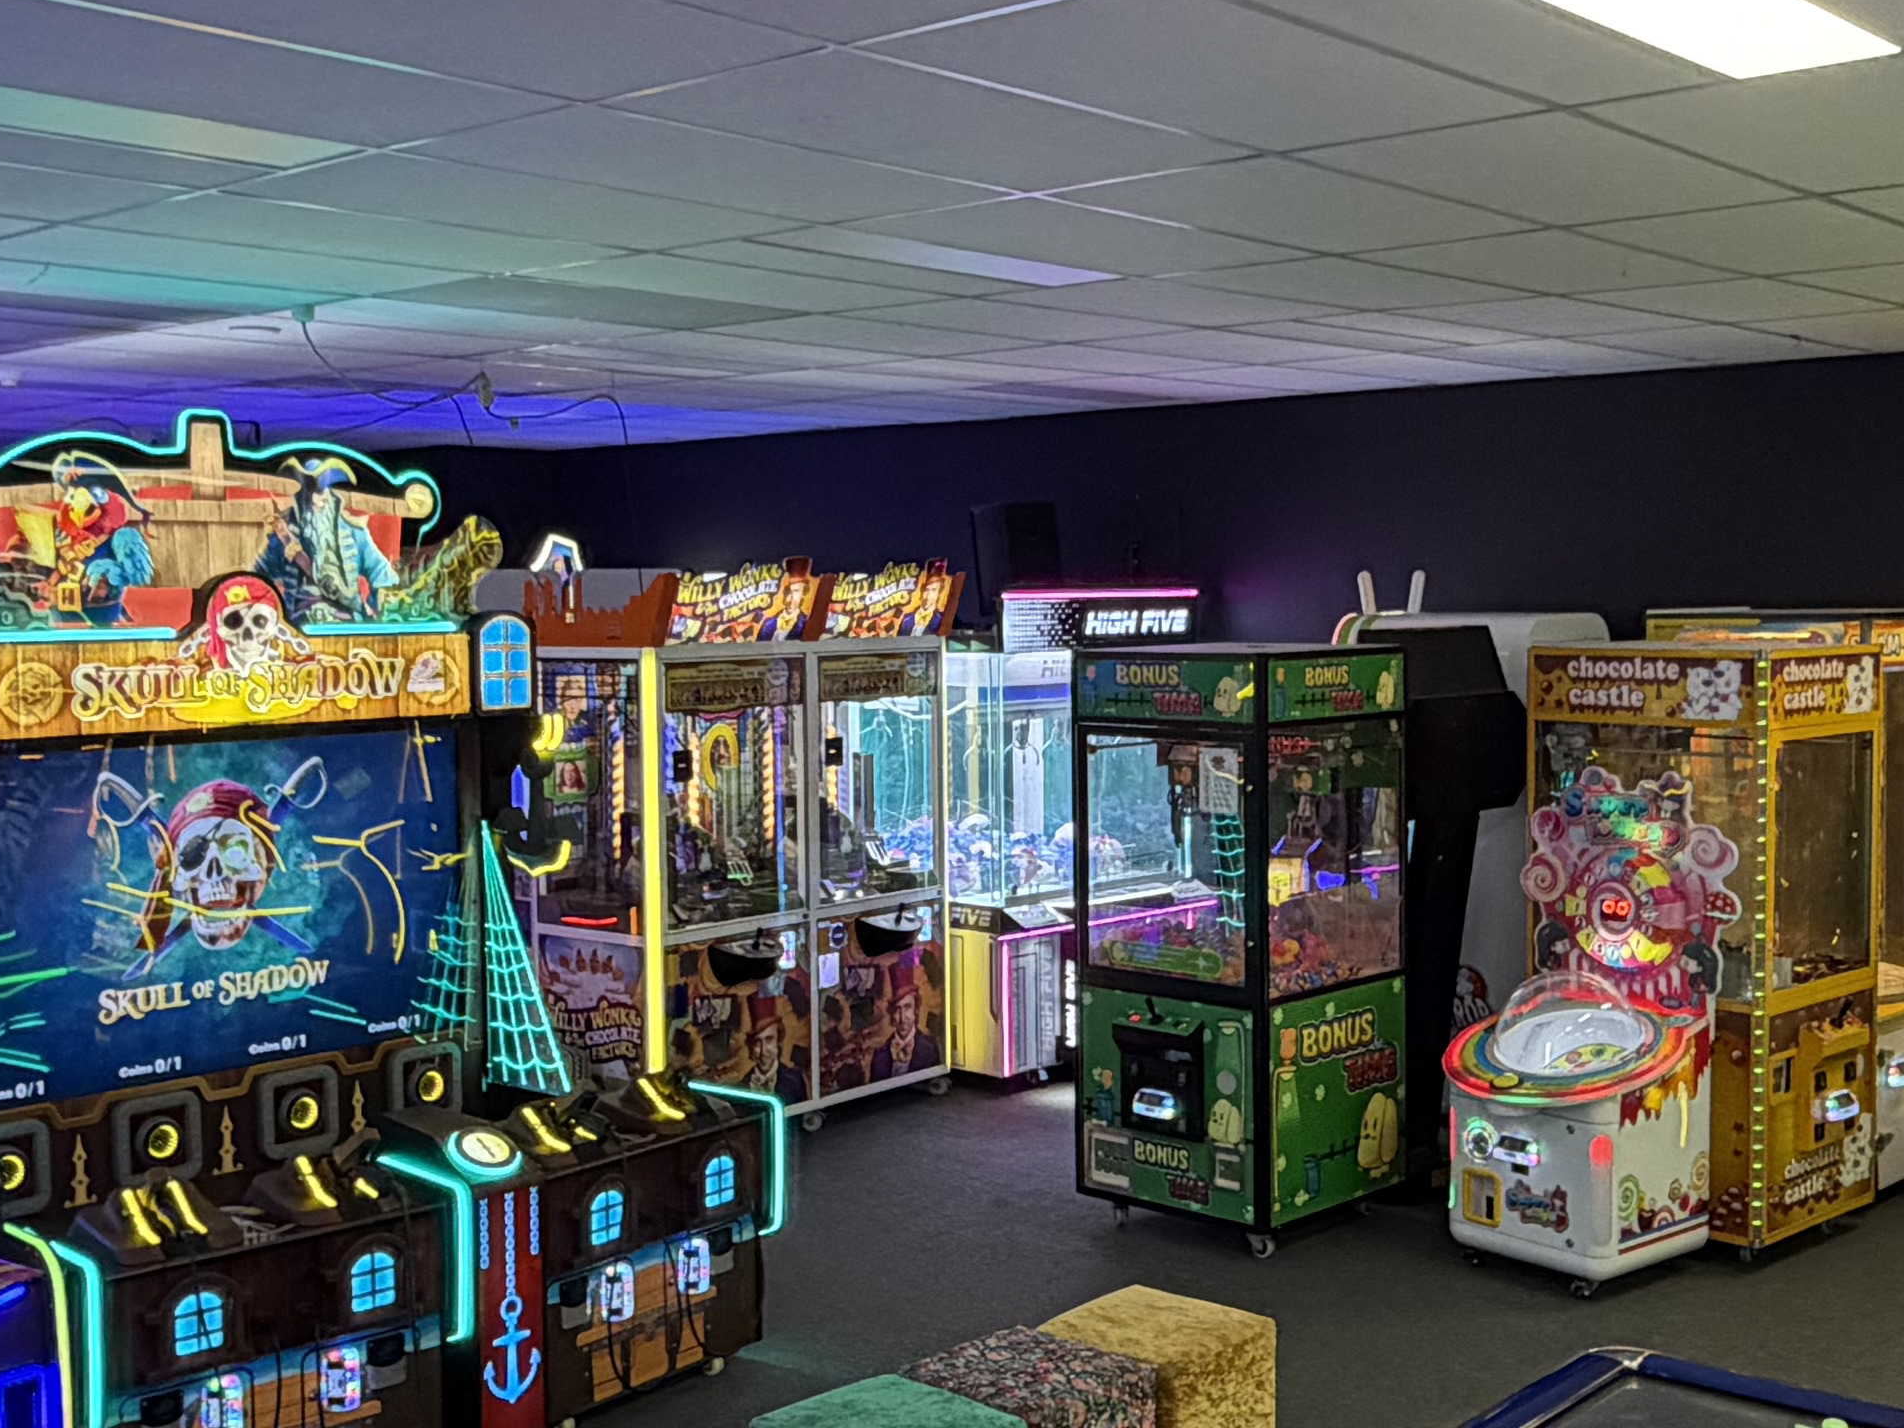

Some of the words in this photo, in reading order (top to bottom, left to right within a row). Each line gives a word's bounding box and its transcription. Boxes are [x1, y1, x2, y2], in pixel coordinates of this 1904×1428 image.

[1084, 610, 1138, 636] HIGH
[1140, 608, 1189, 634] FIVE
[1114, 663, 1180, 687] BONUS
[1304, 665, 1350, 687] BONUS
[1566, 655, 1681, 682] chocolate
[1783, 656, 1845, 683] chocolate
[71, 662, 210, 721] SKULL
[245, 648, 405, 714] SHADOW
[1568, 685, 1645, 710] castle
[1783, 686, 1827, 710] castle
[950, 906, 992, 927] FIVE
[97, 981, 191, 1026] SKULL
[192, 979, 215, 999] OF
[218, 956, 330, 1006] SHADOW
[368, 1020, 397, 1034] Coins
[397, 1014, 421, 1030] 0/1
[1302, 1012, 1375, 1058] BONUS
[248, 1041, 280, 1056] Coins
[281, 1034, 308, 1051] 0/1
[118, 1063, 153, 1079] Coins
[154, 1056, 182, 1074] 0/1
[14, 1080, 46, 1100] 0/1
[1132, 1139, 1190, 1171] BONUS
[1784, 1144, 1841, 1180] chocolate
[1784, 1174, 1827, 1205] castle
